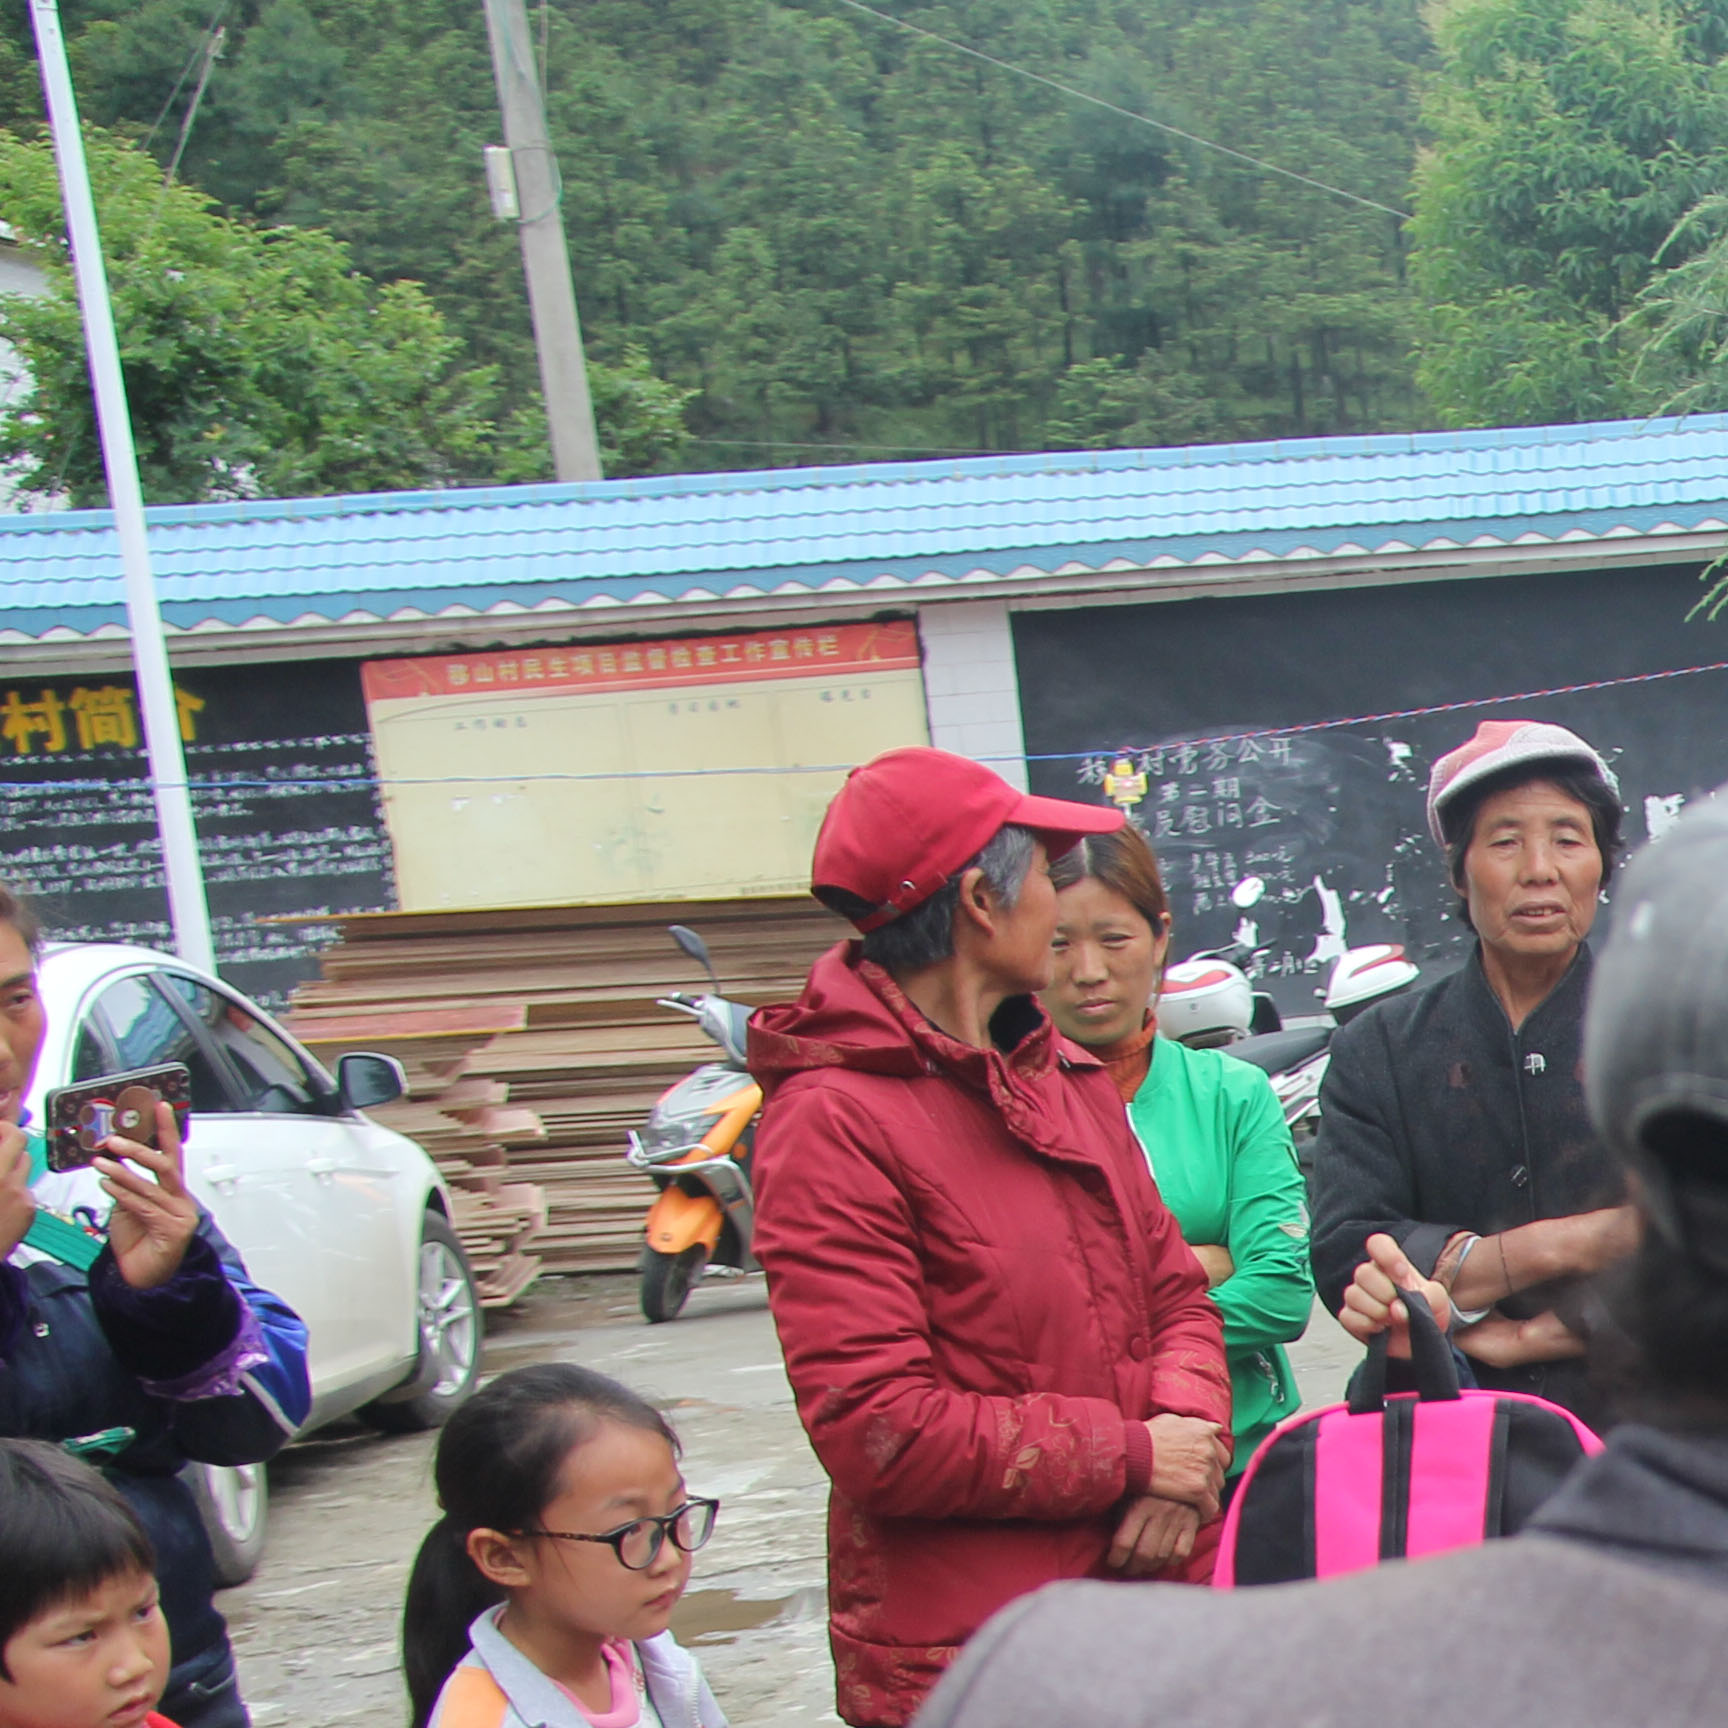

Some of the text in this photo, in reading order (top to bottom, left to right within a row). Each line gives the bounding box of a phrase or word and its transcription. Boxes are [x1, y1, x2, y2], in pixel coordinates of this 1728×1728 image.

[1076, 738, 1293, 785] 移村党务公开
